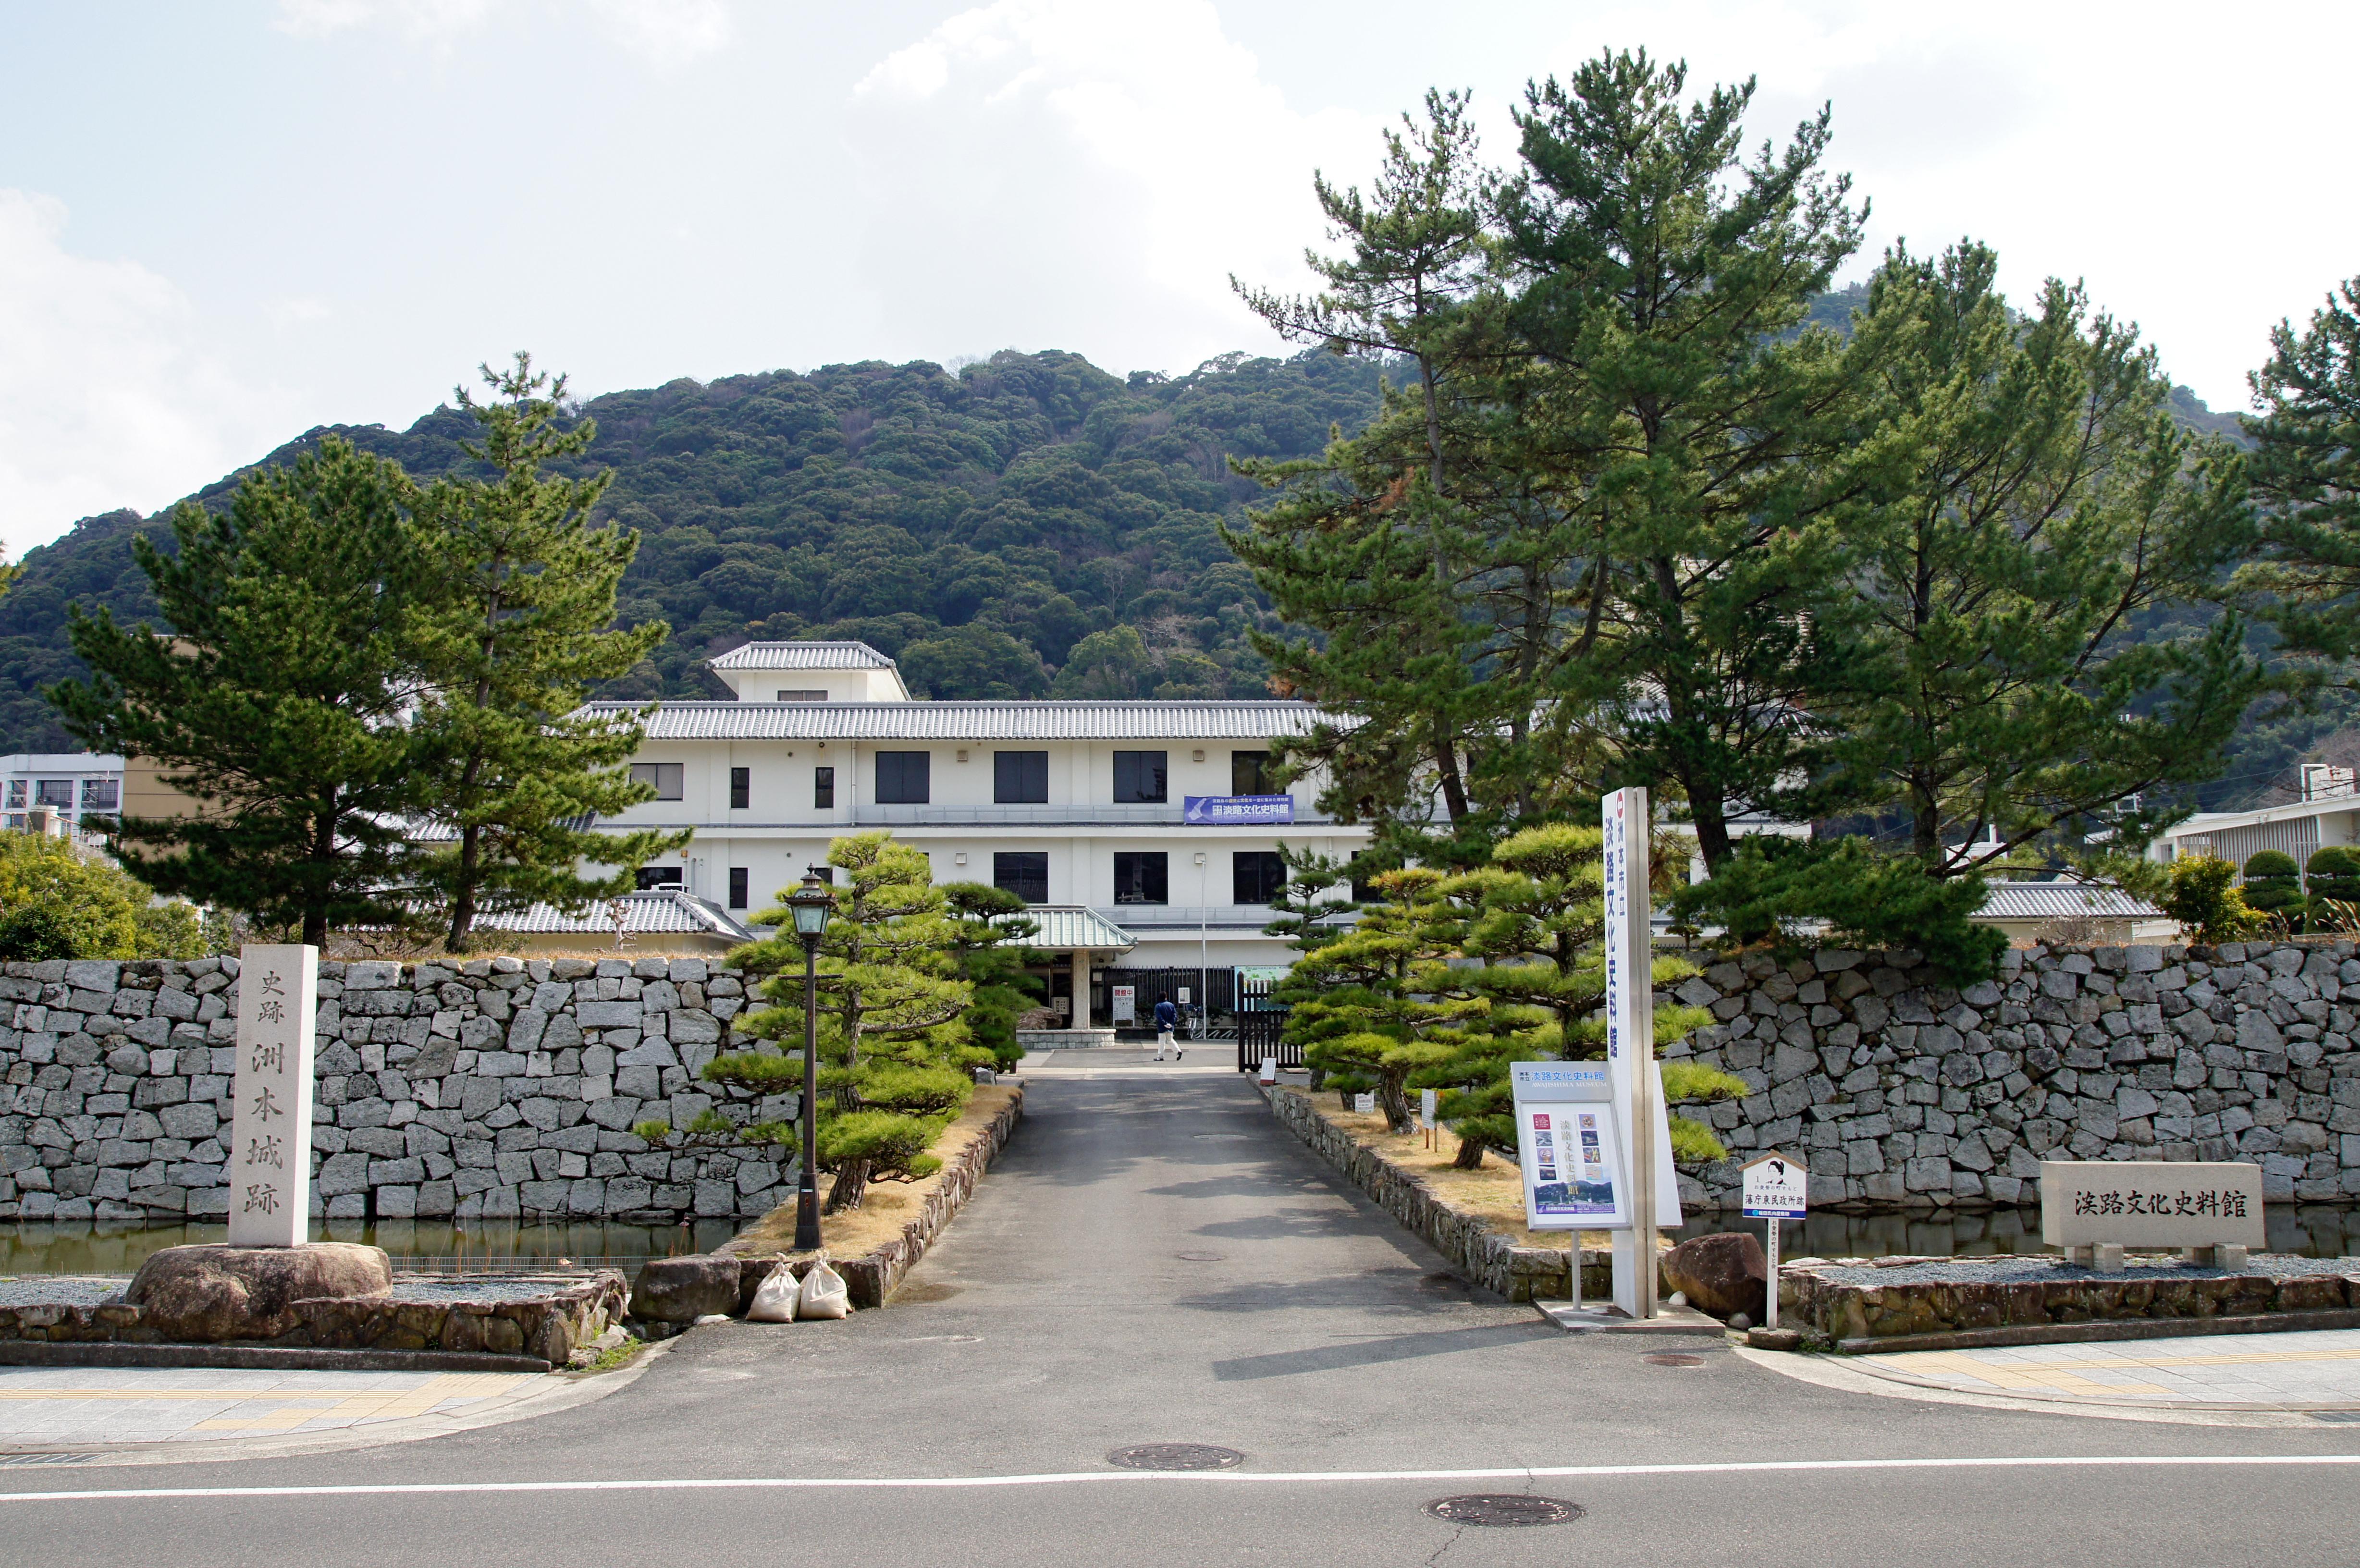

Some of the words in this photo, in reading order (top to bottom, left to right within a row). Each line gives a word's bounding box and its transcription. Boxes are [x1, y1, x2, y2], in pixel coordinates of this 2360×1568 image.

[1223, 804, 1289, 815] 淡路文化史料館
[1617, 821, 1625, 917] 洲本市立
[1605, 815, 1618, 1058] 淡路文化史料館
[1531, 1071, 1604, 1081] 淡路文化史料館
[1560, 1120, 1579, 1195] 淡路文化史料館
[2075, 1189, 2248, 1218] 淡路文化史料館
